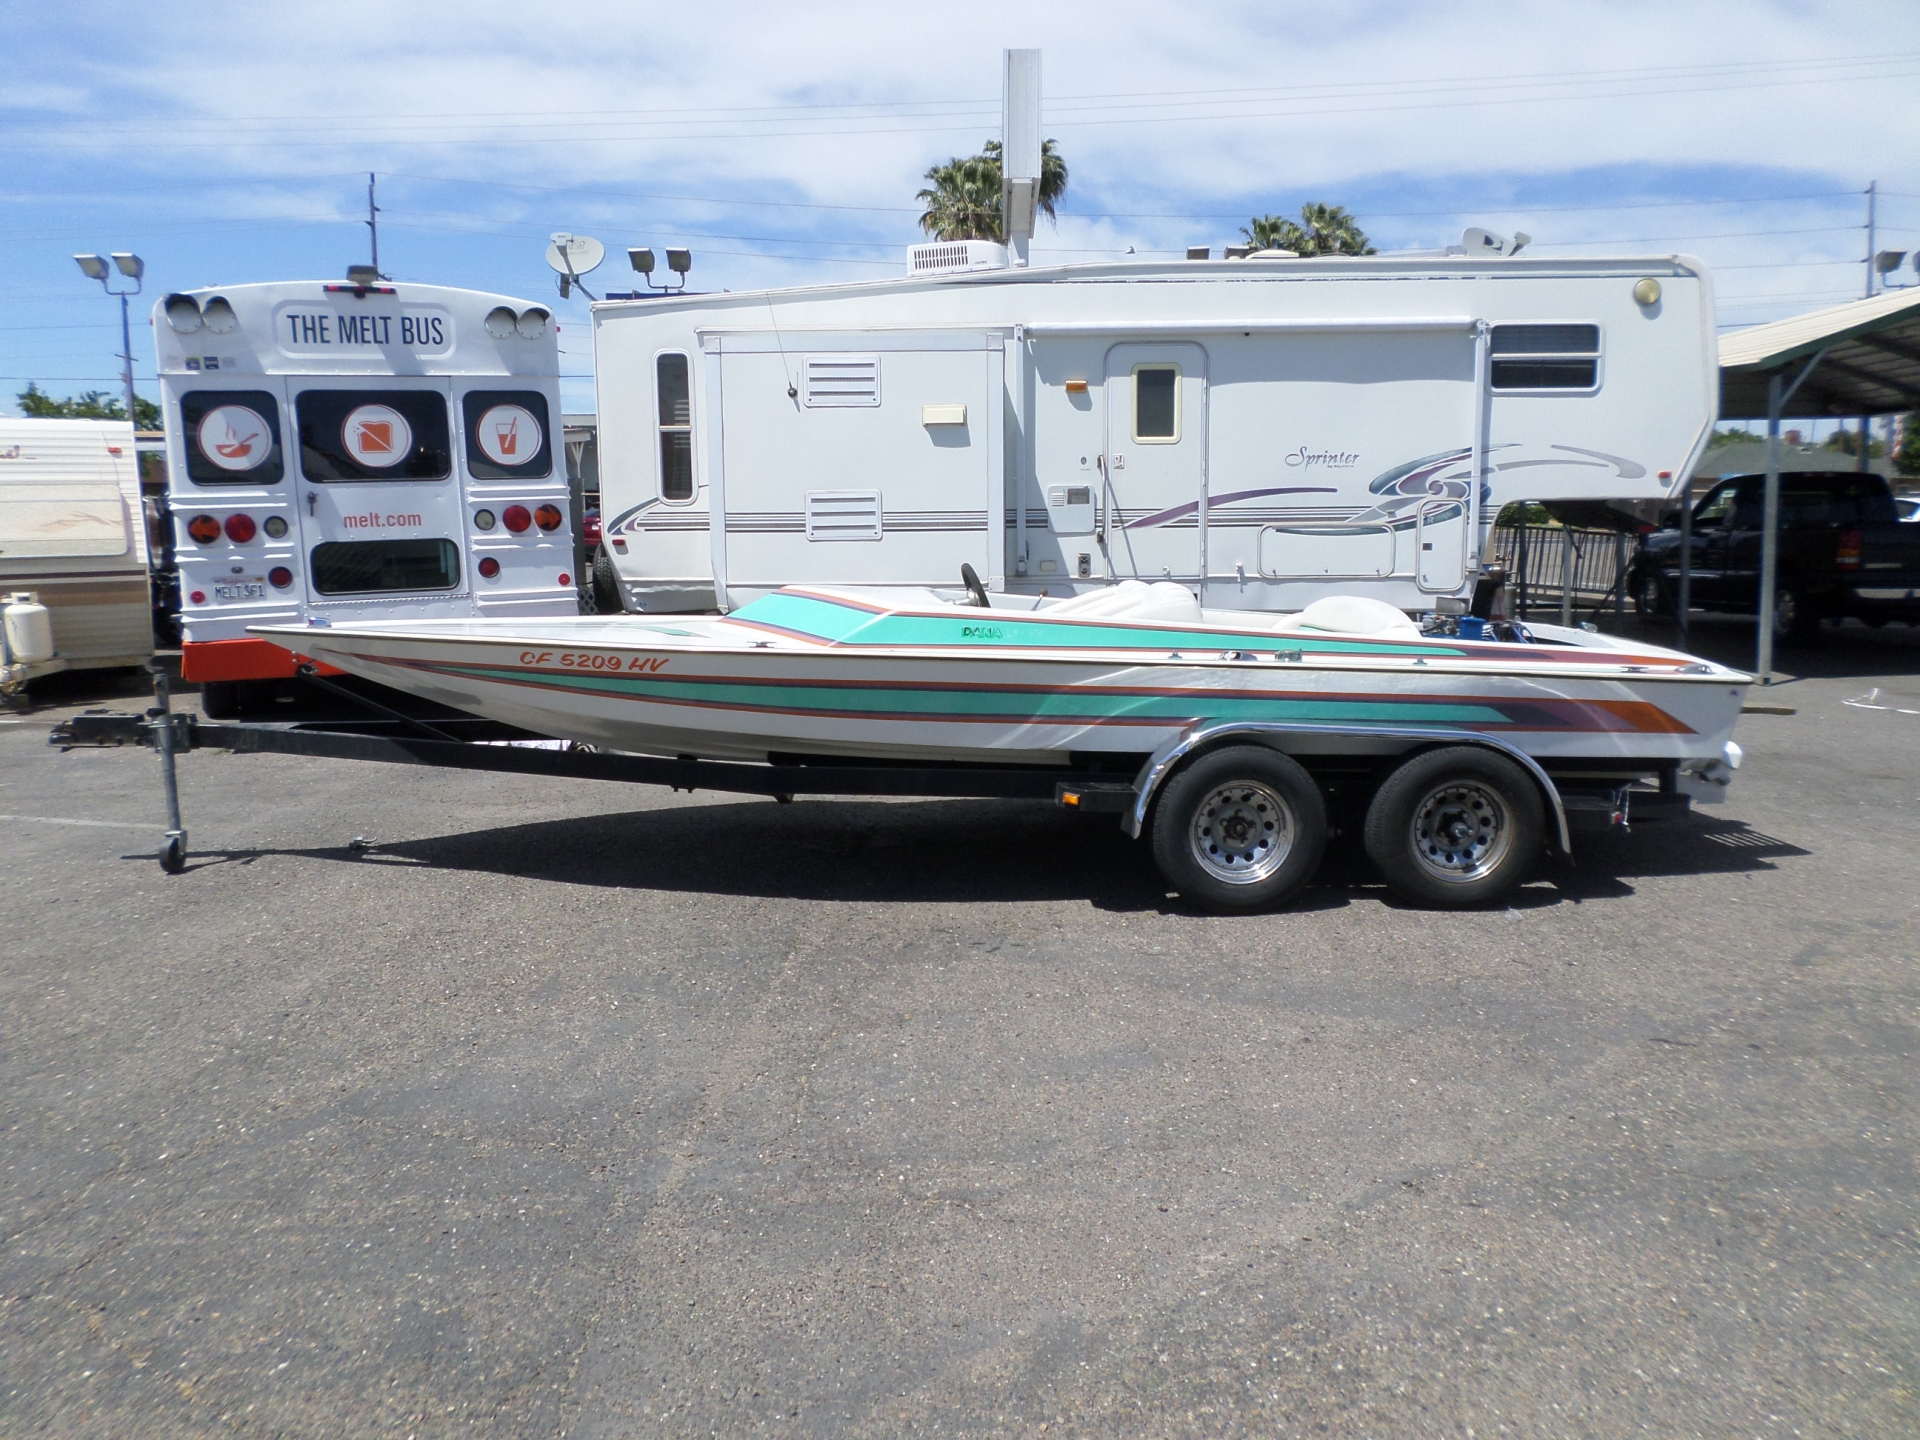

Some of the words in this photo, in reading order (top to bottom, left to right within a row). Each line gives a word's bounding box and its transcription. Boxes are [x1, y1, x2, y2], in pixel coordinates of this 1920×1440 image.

[286, 314, 332, 344] THE
[337, 315, 392, 345] MELT
[401, 316, 444, 346] BUS
[1284, 445, 1360, 472] Sprinter
[343, 511, 422, 528] melt.com
[519, 651, 554, 665] CF
[559, 653, 622, 671] 5209
[628, 657, 670, 672] HV
